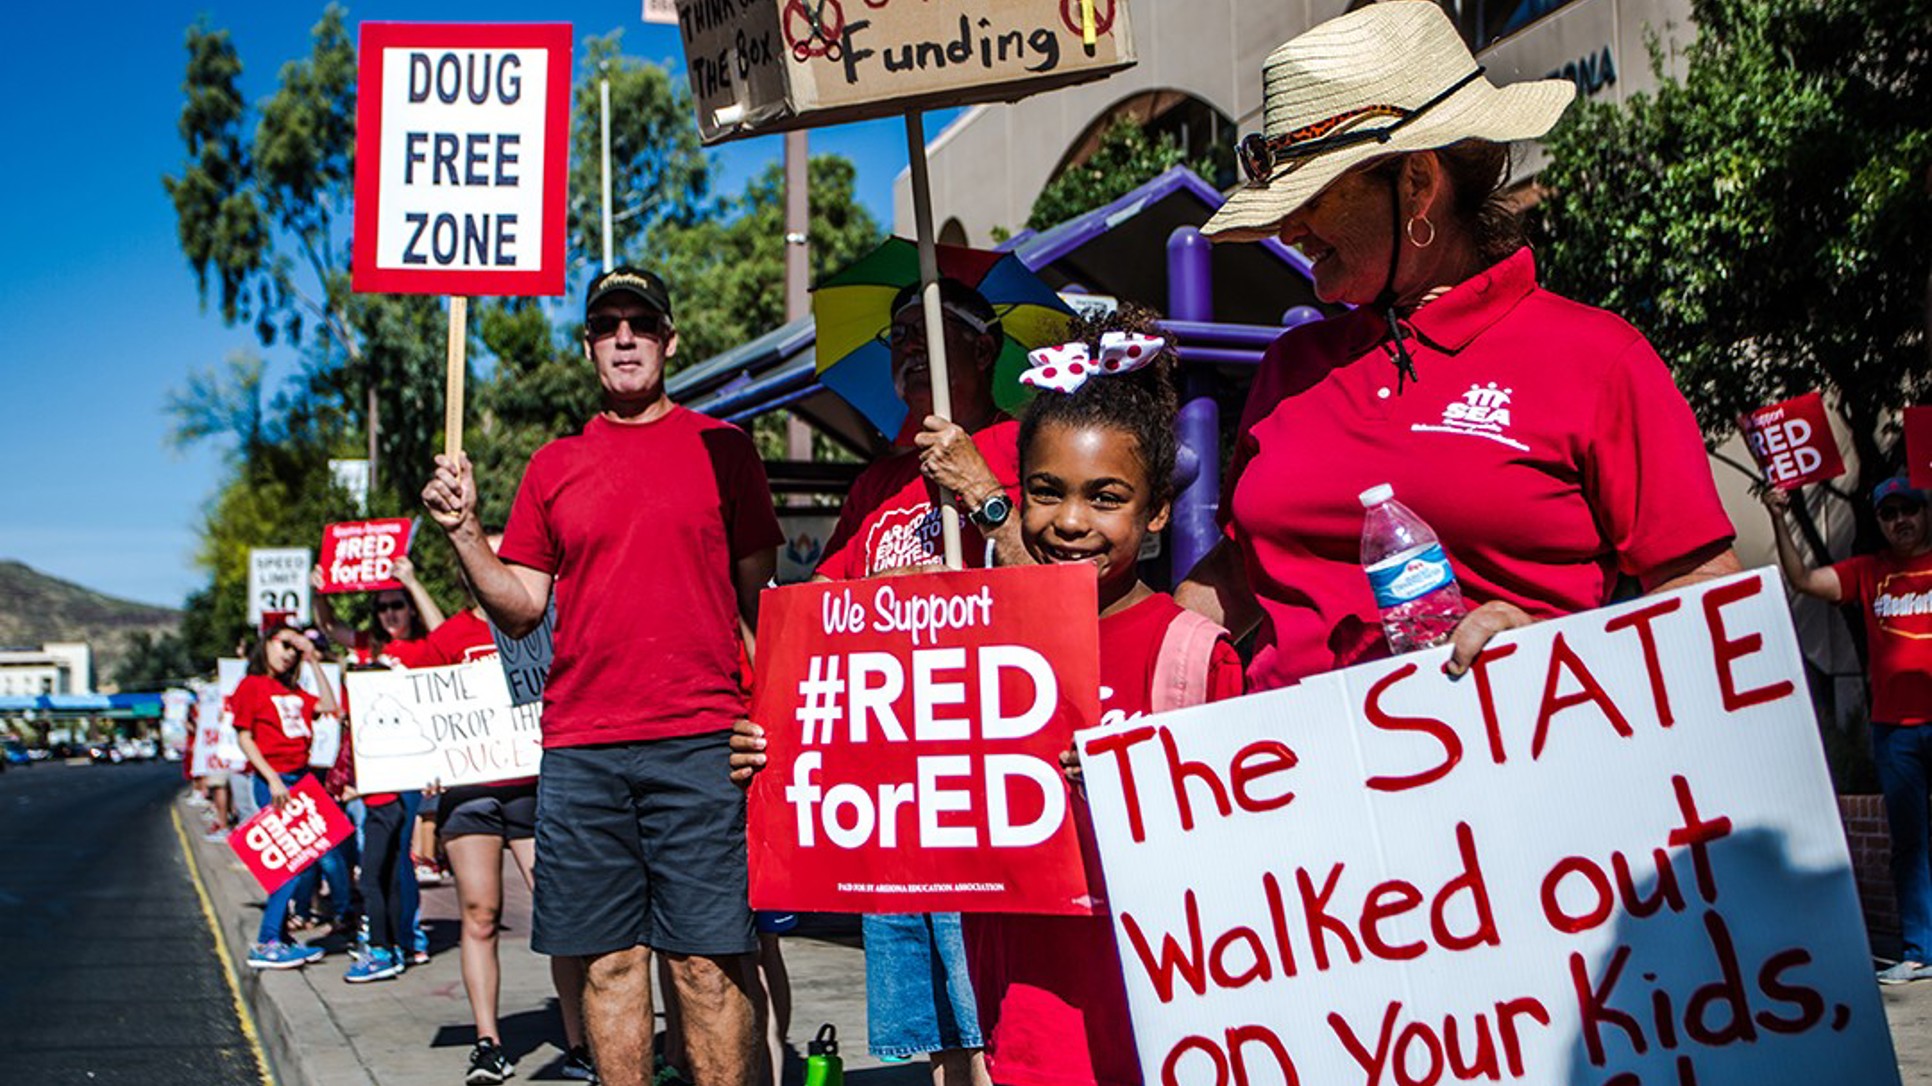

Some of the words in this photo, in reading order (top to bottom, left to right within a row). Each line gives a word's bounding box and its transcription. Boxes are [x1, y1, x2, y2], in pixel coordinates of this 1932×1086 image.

[693, 49, 731, 99] THE
[842, 13, 1060, 84] Funding
[408, 52, 522, 105] DOUG
[404, 132, 521, 187] FREE
[402, 212, 518, 266] ZONE
[335, 534, 396, 560] #RED
[880, 507, 943, 543] ARIZON
[256, 557, 304, 569] SPEED
[259, 573, 299, 585] LIMIT
[330, 558, 394, 584] forED
[822, 590, 865, 635] We
[873, 585, 994, 645] Support
[405, 666, 478, 704] TIME
[796, 644, 1059, 745] #RED
[1085, 724, 1299, 843] The
[1363, 574, 1795, 791] STATE
[431, 707, 495, 742] DROP
[785, 750, 1067, 849] forED
[908, 883, 952, 893] EDUCATION
[954, 883, 1005, 892] ASSOCIATION
[1120, 821, 1501, 1004] Walked
[1540, 774, 1732, 934] out
